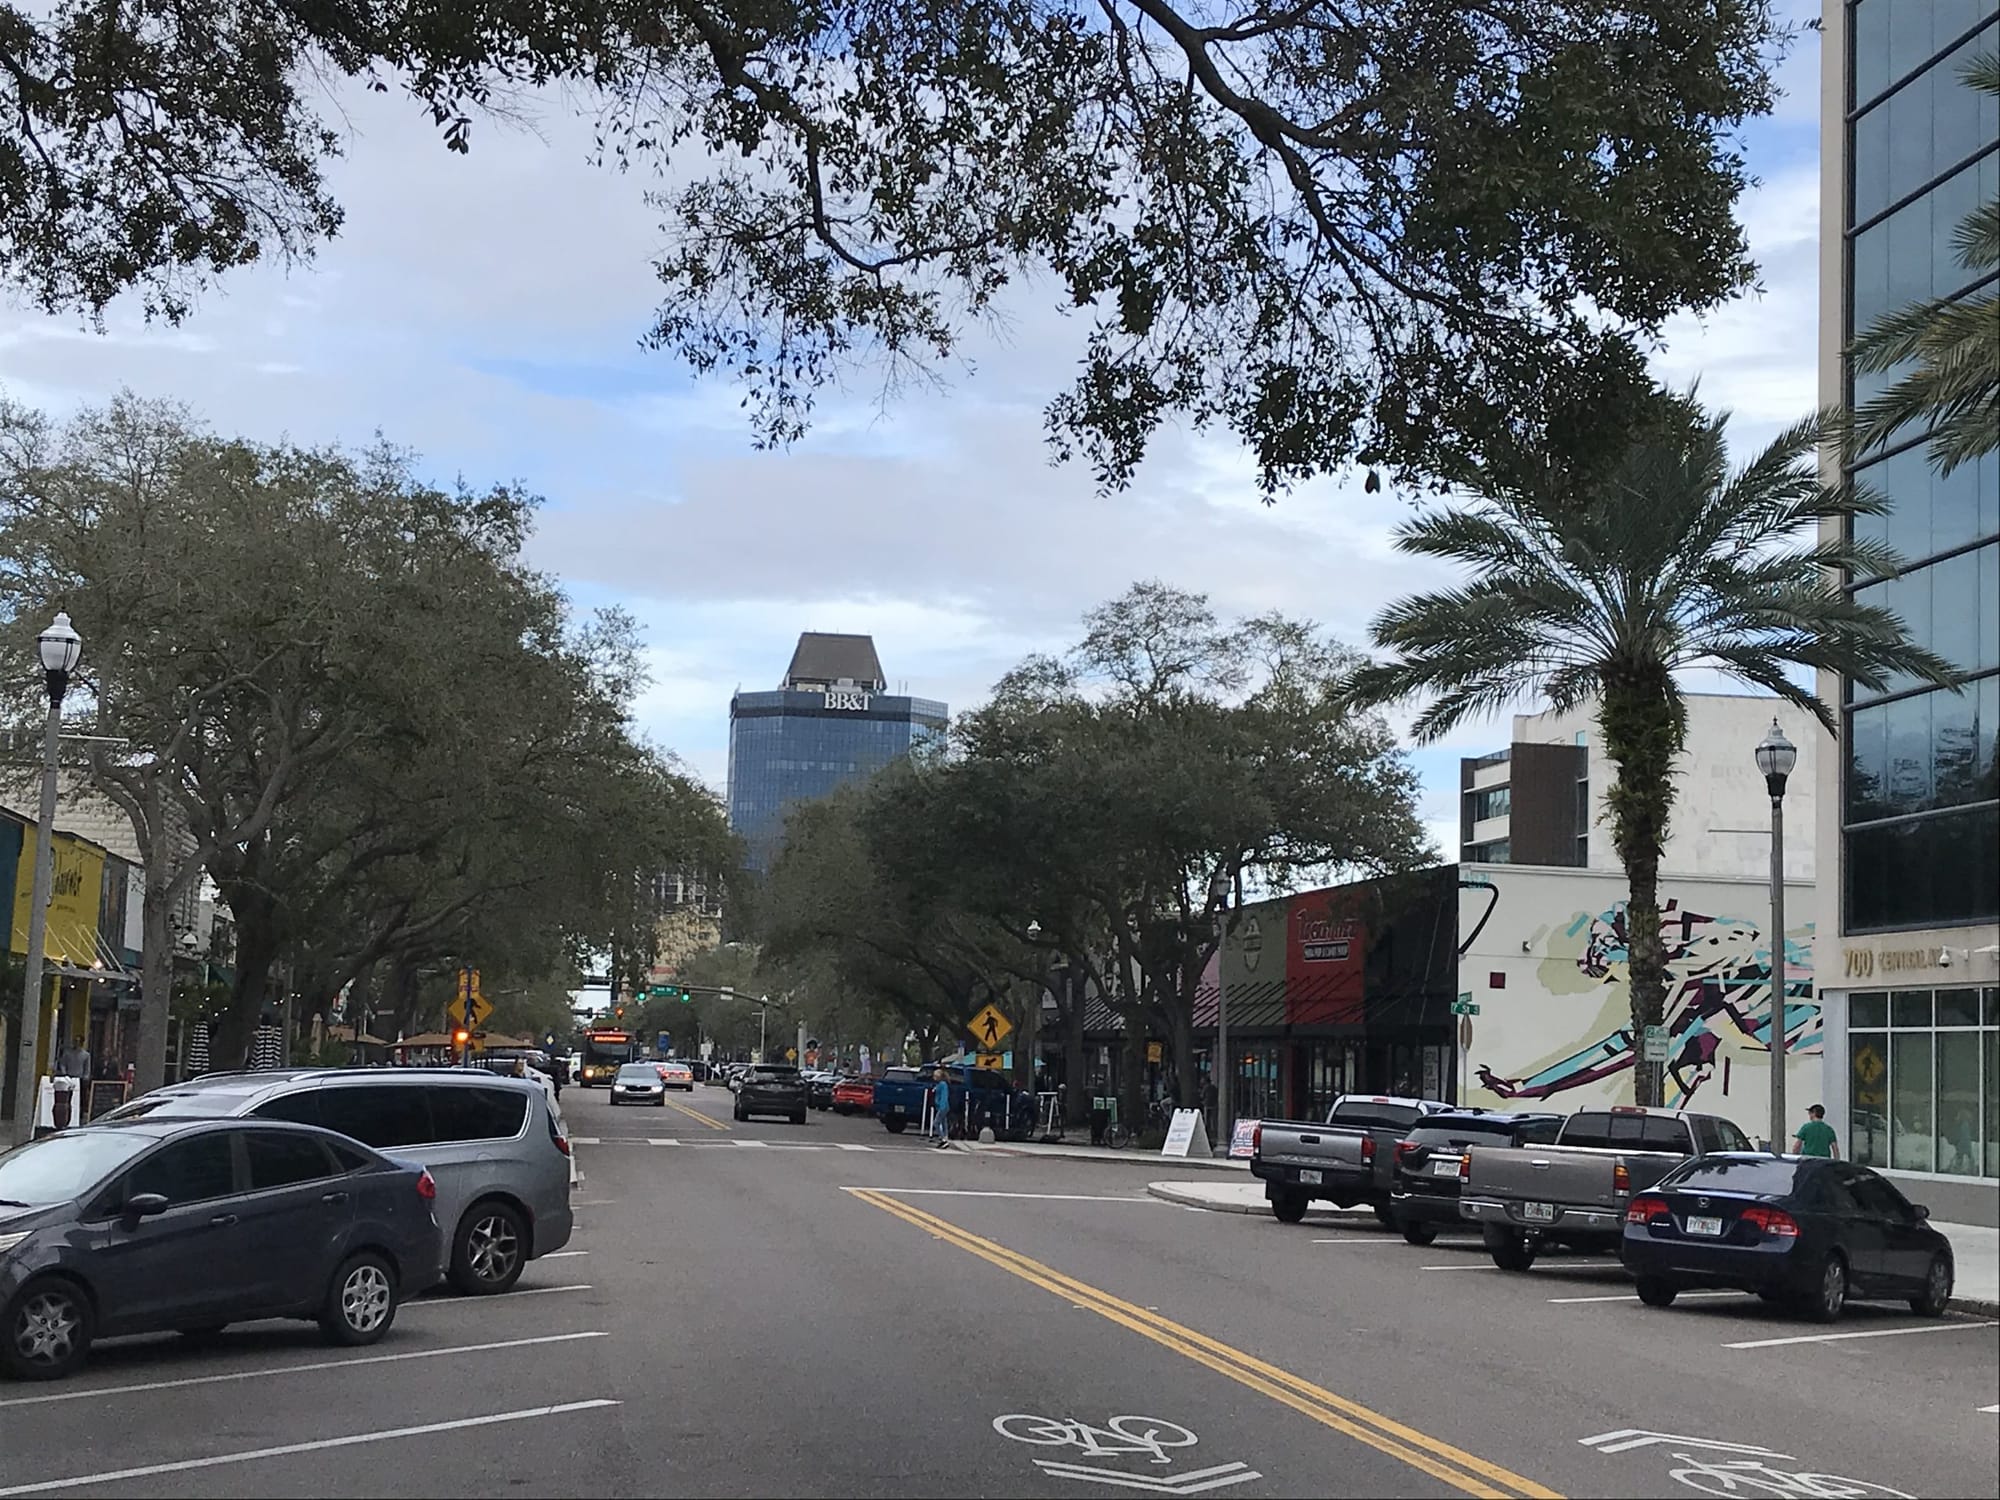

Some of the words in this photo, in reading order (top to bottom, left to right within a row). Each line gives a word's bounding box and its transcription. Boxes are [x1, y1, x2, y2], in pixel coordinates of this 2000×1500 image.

[823, 691, 874, 711] BB&T
[1843, 949, 1874, 979] 700
[1879, 949, 1927, 972] CENTRAL
